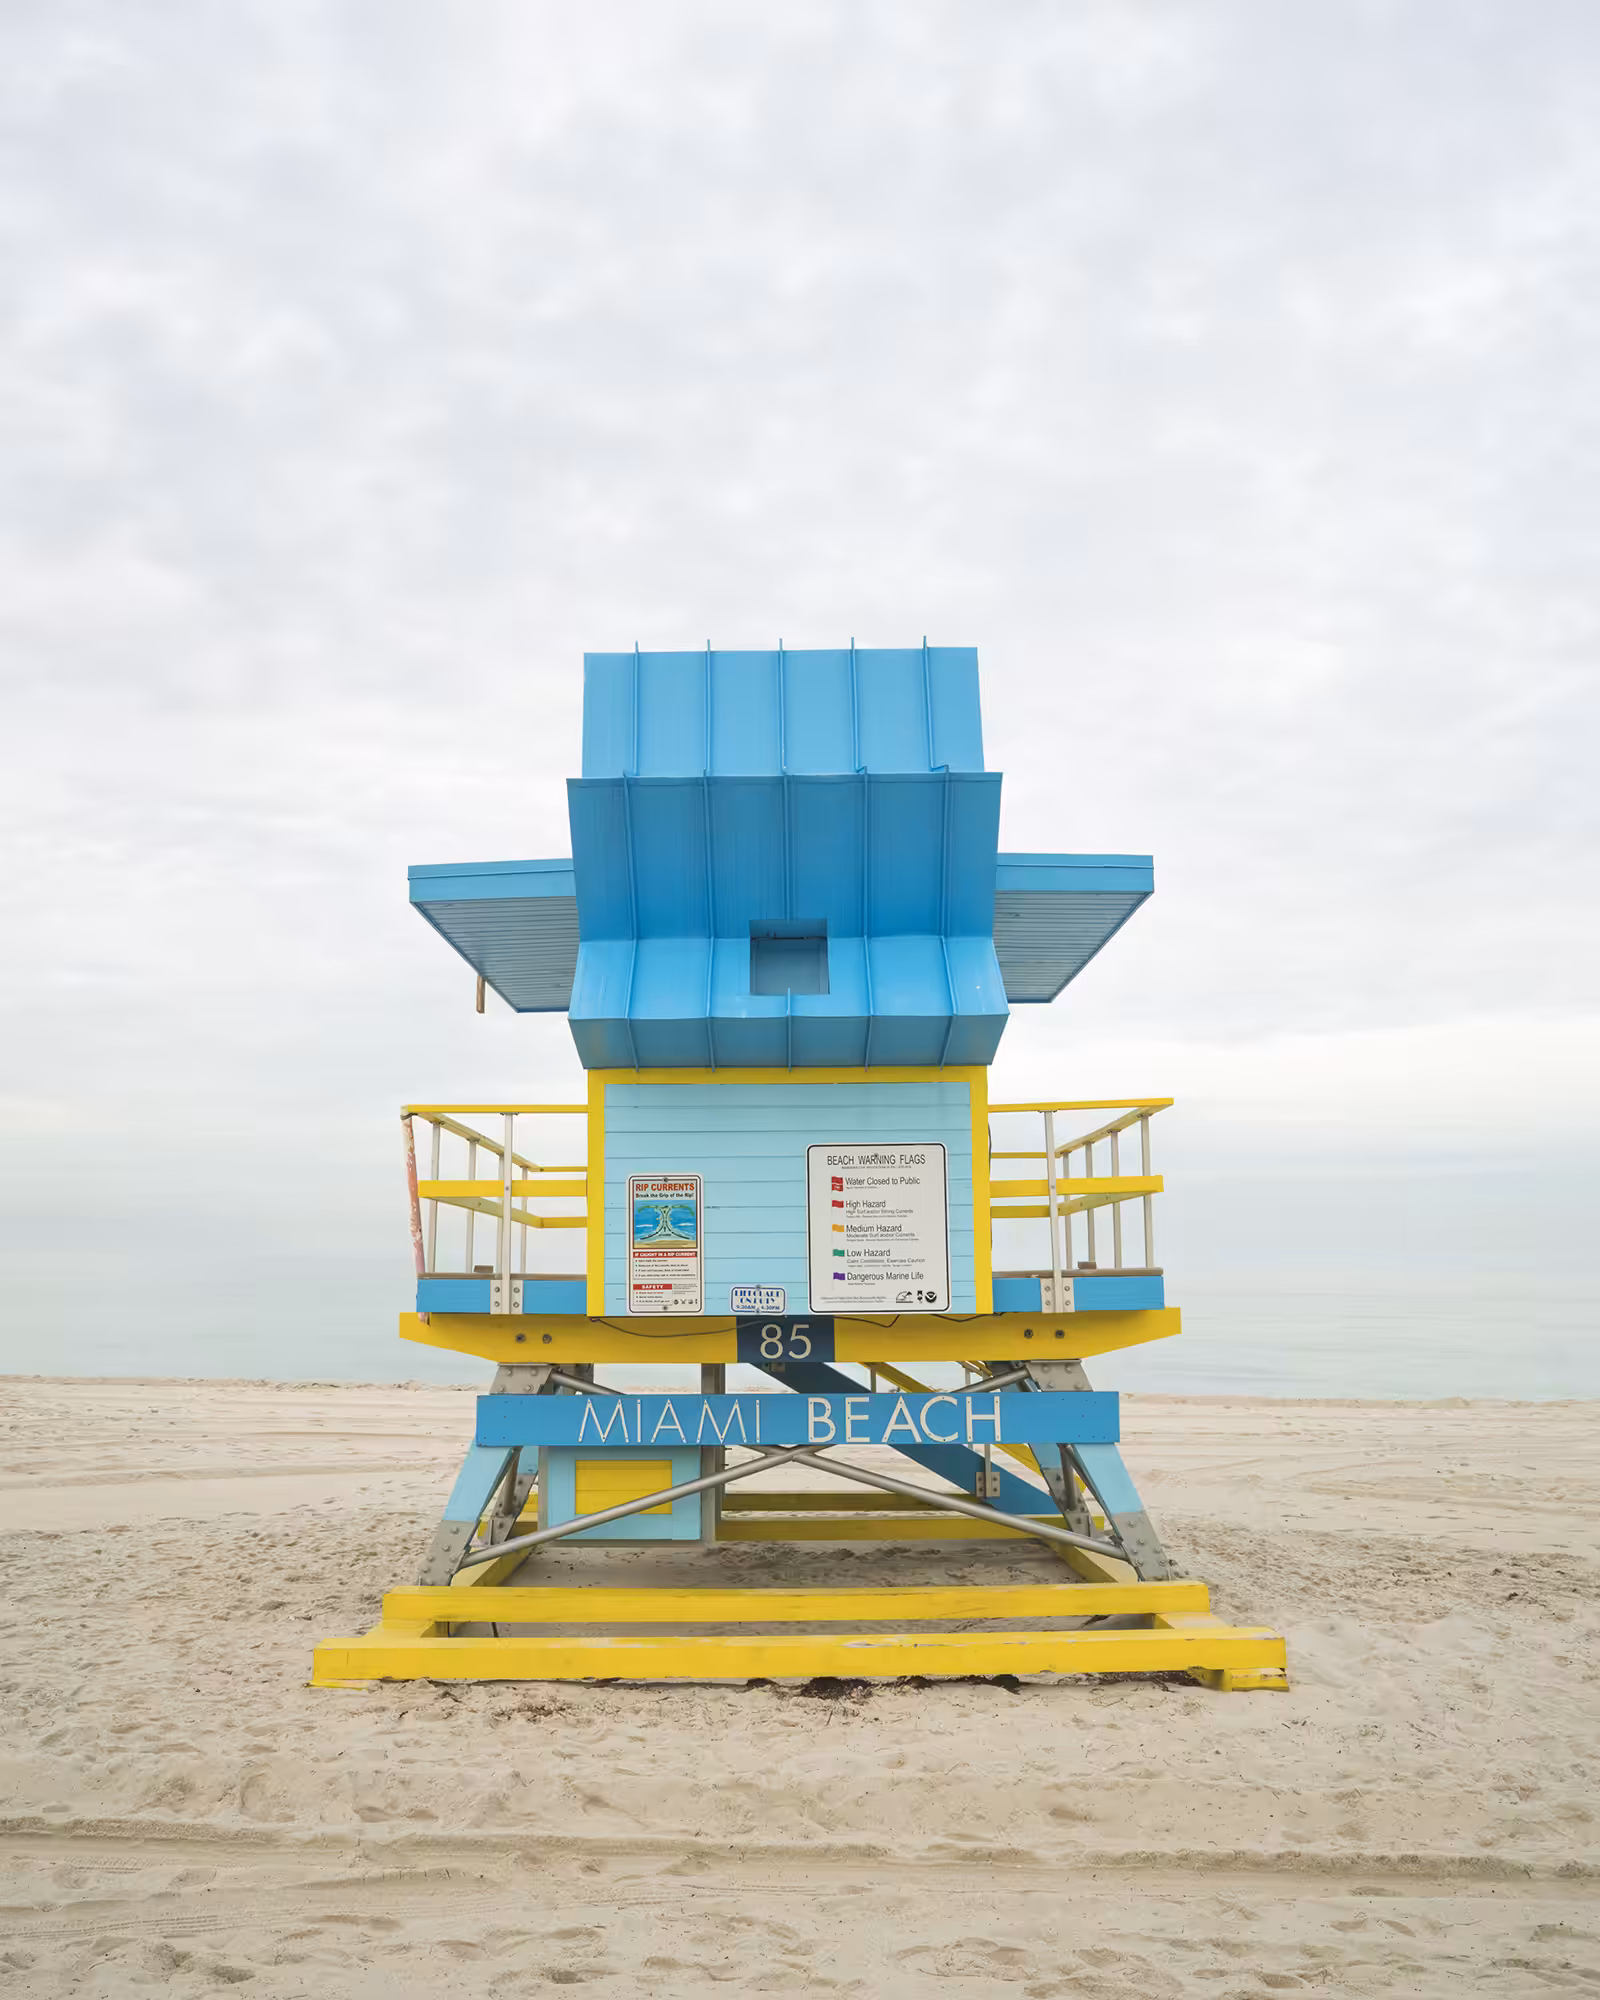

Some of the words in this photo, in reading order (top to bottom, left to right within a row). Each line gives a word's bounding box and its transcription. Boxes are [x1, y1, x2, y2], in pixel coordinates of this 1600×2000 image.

[827, 1155, 854, 1166] BEACH
[858, 1154, 896, 1165] WARNING
[900, 1154, 926, 1165] FLAGS
[845, 1177, 865, 1185] Water
[867, 1177, 890, 1185] Closed
[891, 1177, 898, 1185] to
[900, 1176, 920, 1185] Public
[636, 1183, 649, 1191] RIP
[651, 1183, 695, 1191] CURRENTS
[846, 1200, 860, 1210] High
[862, 1200, 886, 1208] Hazard
[846, 1225, 874, 1233] Medium
[876, 1224, 902, 1232] Hazard
[846, 1249, 862, 1257] Low
[864, 1249, 891, 1257] Hazard
[847, 1272, 884, 1282] Dangerous
[886, 1272, 910, 1280] Marine
[911, 1271, 924, 1280] Life
[760, 1323, 812, 1359] 85
[578, 1399, 761, 1444] MIAMI
[808, 1395, 1001, 1443] BEACH
